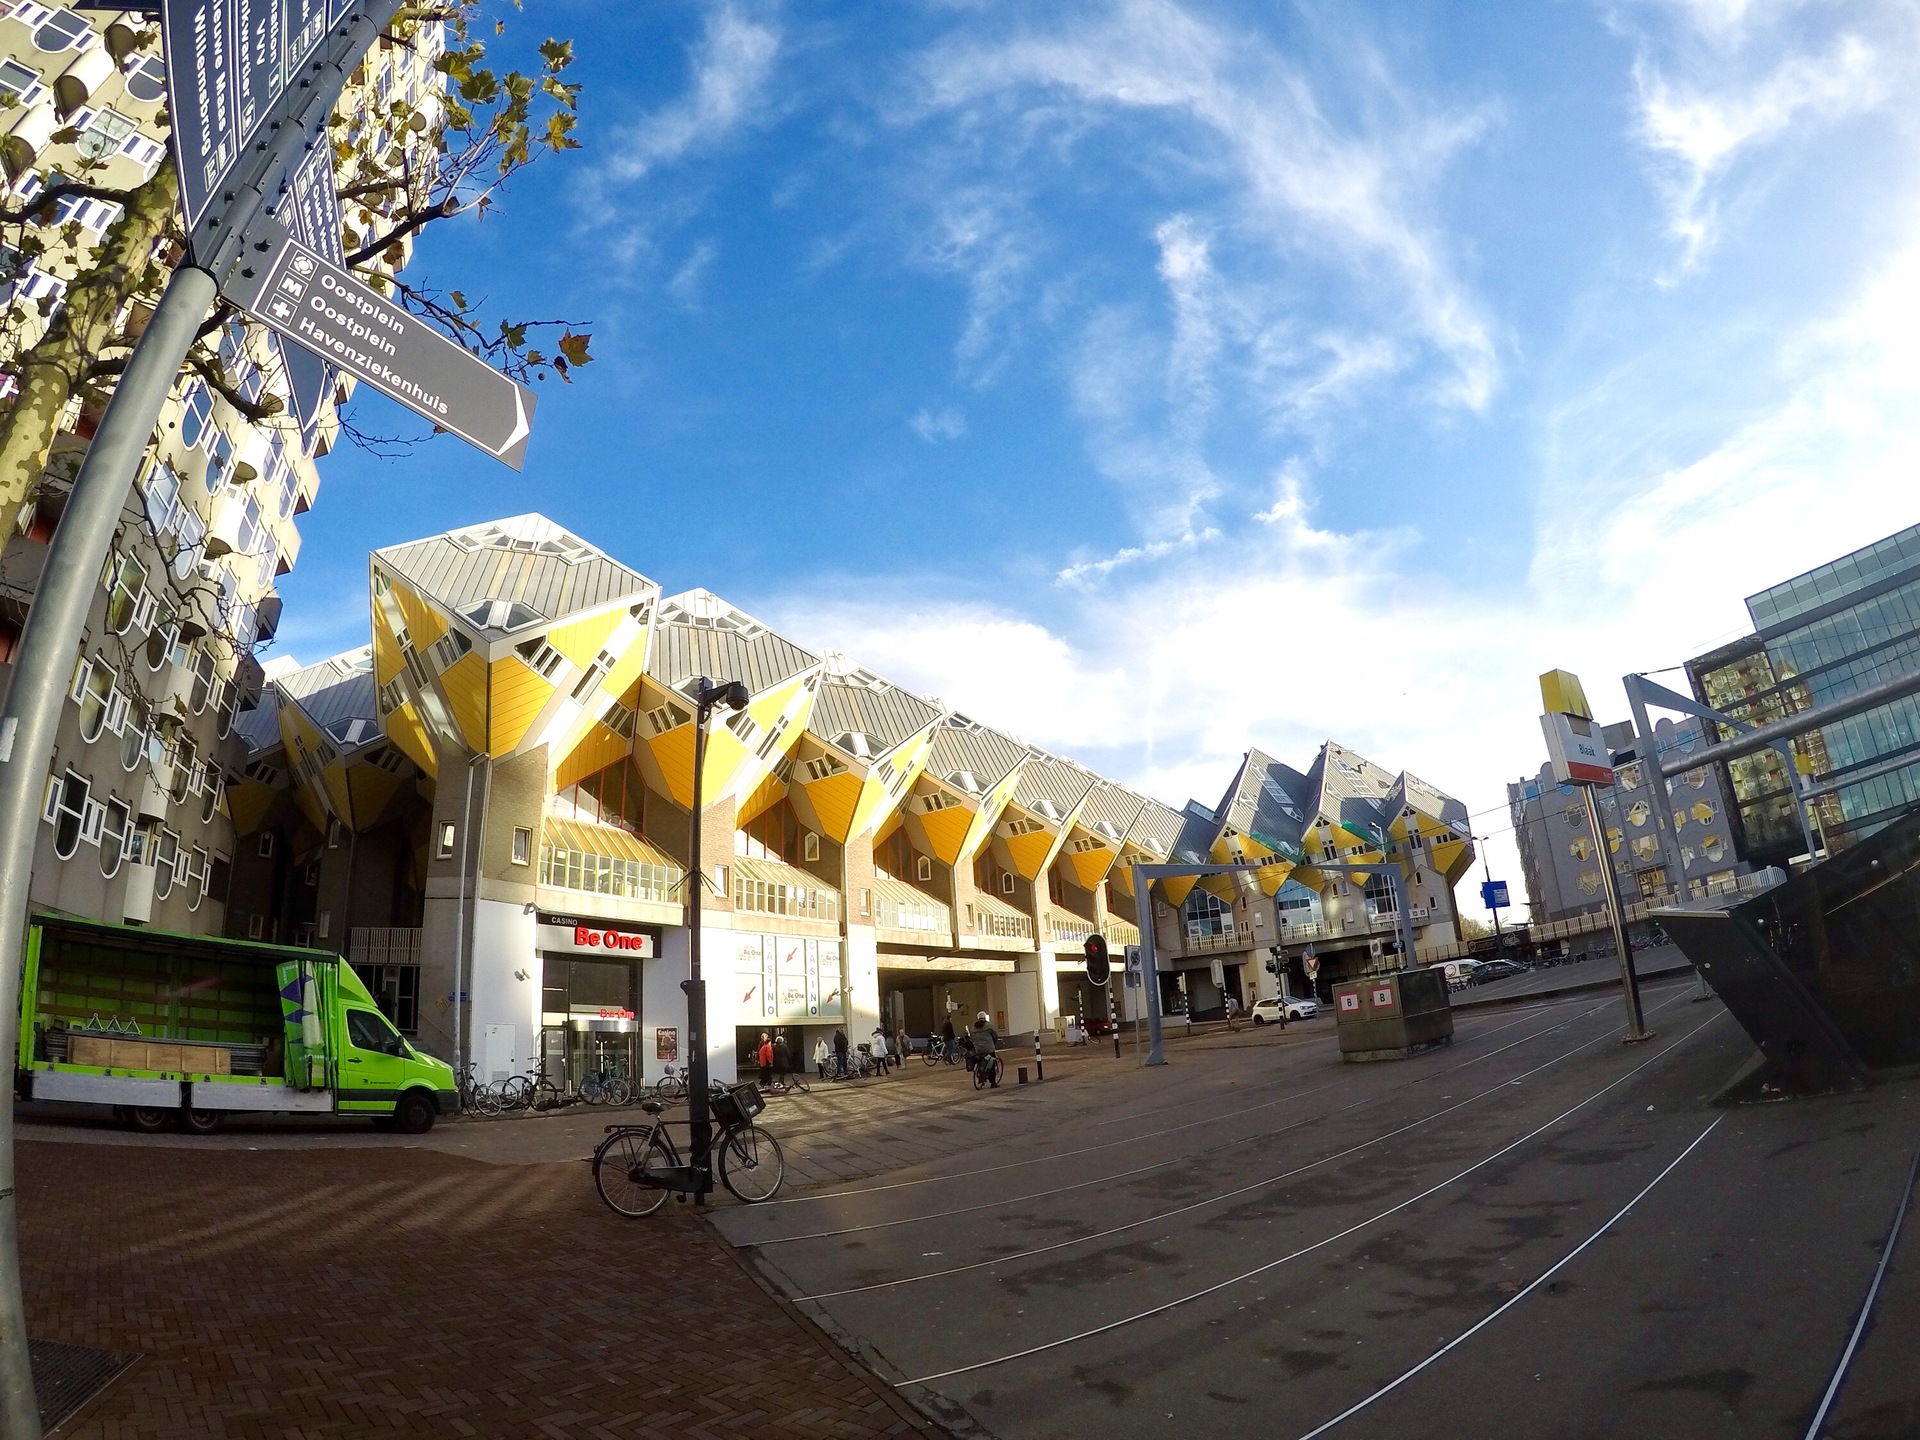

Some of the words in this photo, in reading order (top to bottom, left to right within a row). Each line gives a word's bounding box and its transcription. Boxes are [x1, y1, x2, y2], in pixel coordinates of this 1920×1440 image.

[212, 0, 223, 69] ieuwe
[256, 18, 265, 65] VVV
[194, 4, 212, 157] Willemsbrug
[216, 71, 227, 132] Maas
[313, 184, 323, 227] Oude
[321, 167, 333, 223] Rondje
[310, 295, 397, 357] Oostplein
[321, 274, 405, 335] Oostplein
[299, 316, 449, 415] Havenziekenhuis
[1578, 743, 1596, 757] Blaak
[551, 916, 578, 926] CASINO
[575, 927, 600, 946] Be
[603, 929, 643, 950] One
[766, 938, 775, 1015] CASINO
[809, 941, 817, 1015] CASINO
[1347, 998, 1352, 1006] B
[1380, 994, 1385, 1002] B
[600, 1009, 615, 1017] Be
